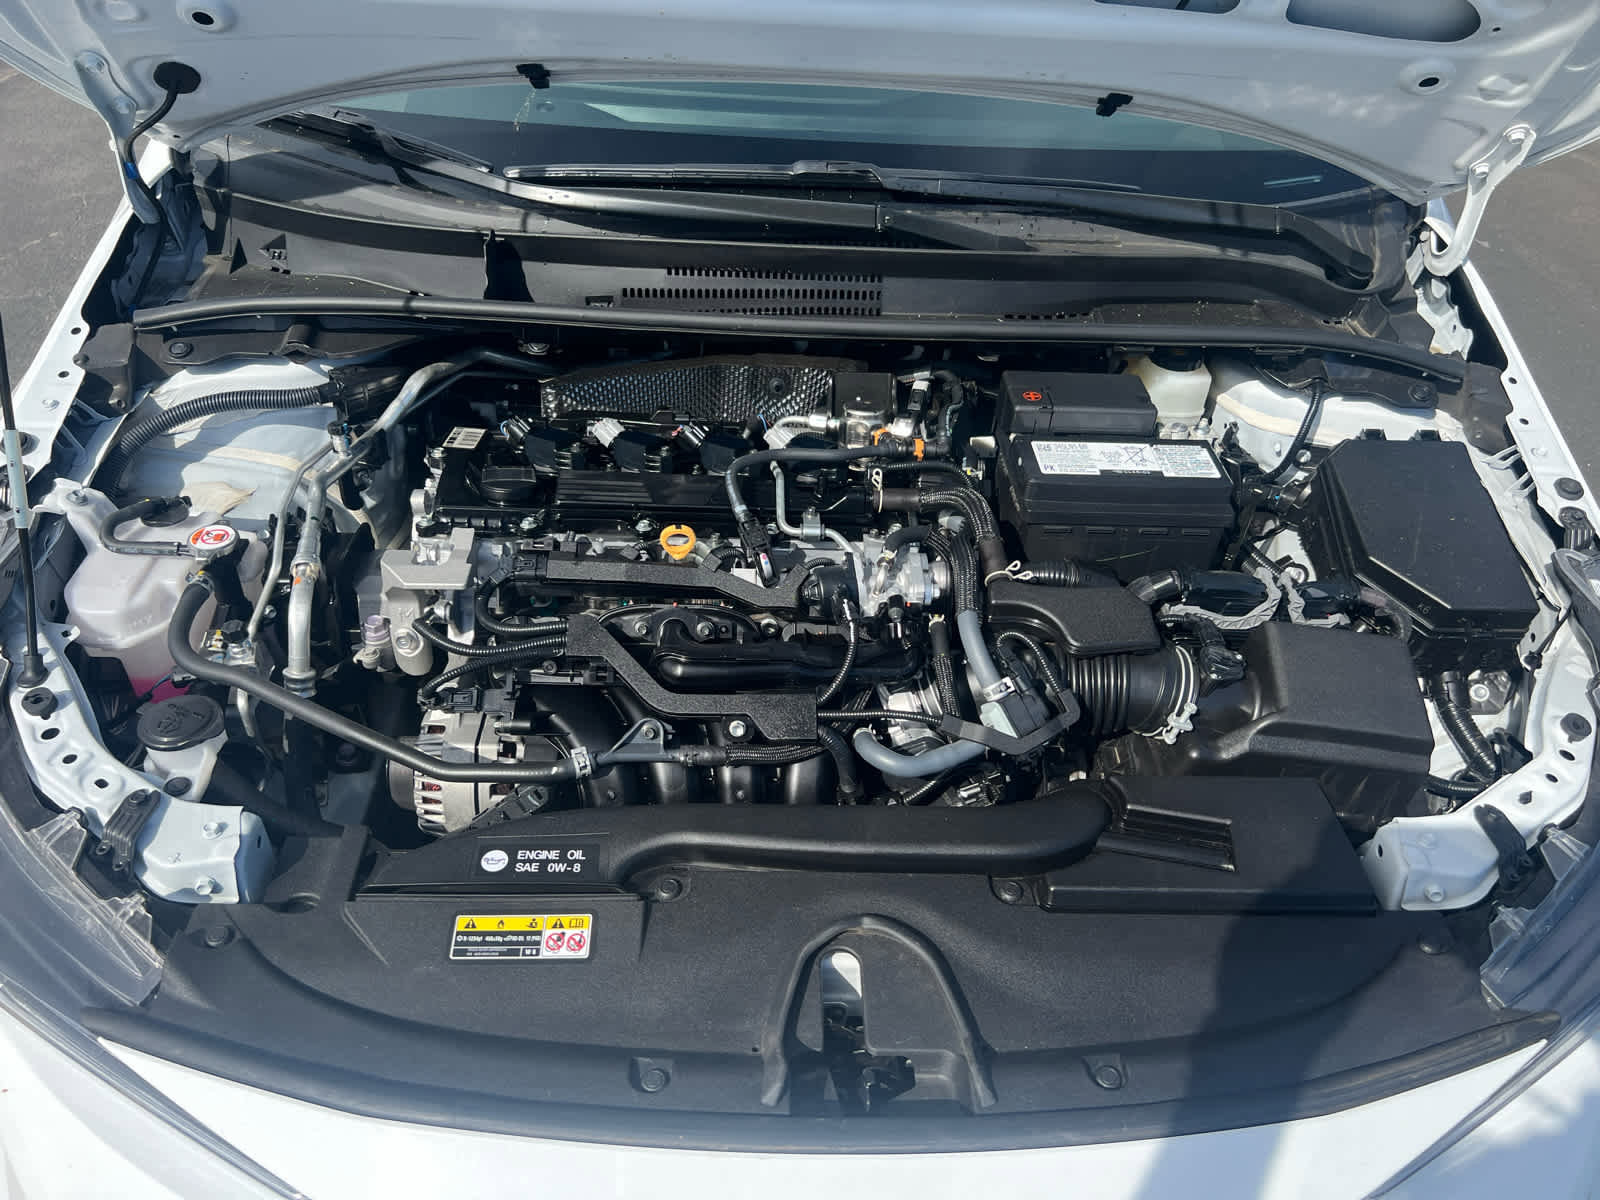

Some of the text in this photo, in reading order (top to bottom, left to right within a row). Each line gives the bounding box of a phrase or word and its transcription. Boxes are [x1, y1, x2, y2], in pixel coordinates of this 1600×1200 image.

[517, 849, 586, 860] ENGINE OIL
[515, 862, 581, 873] SAE 0W-8
